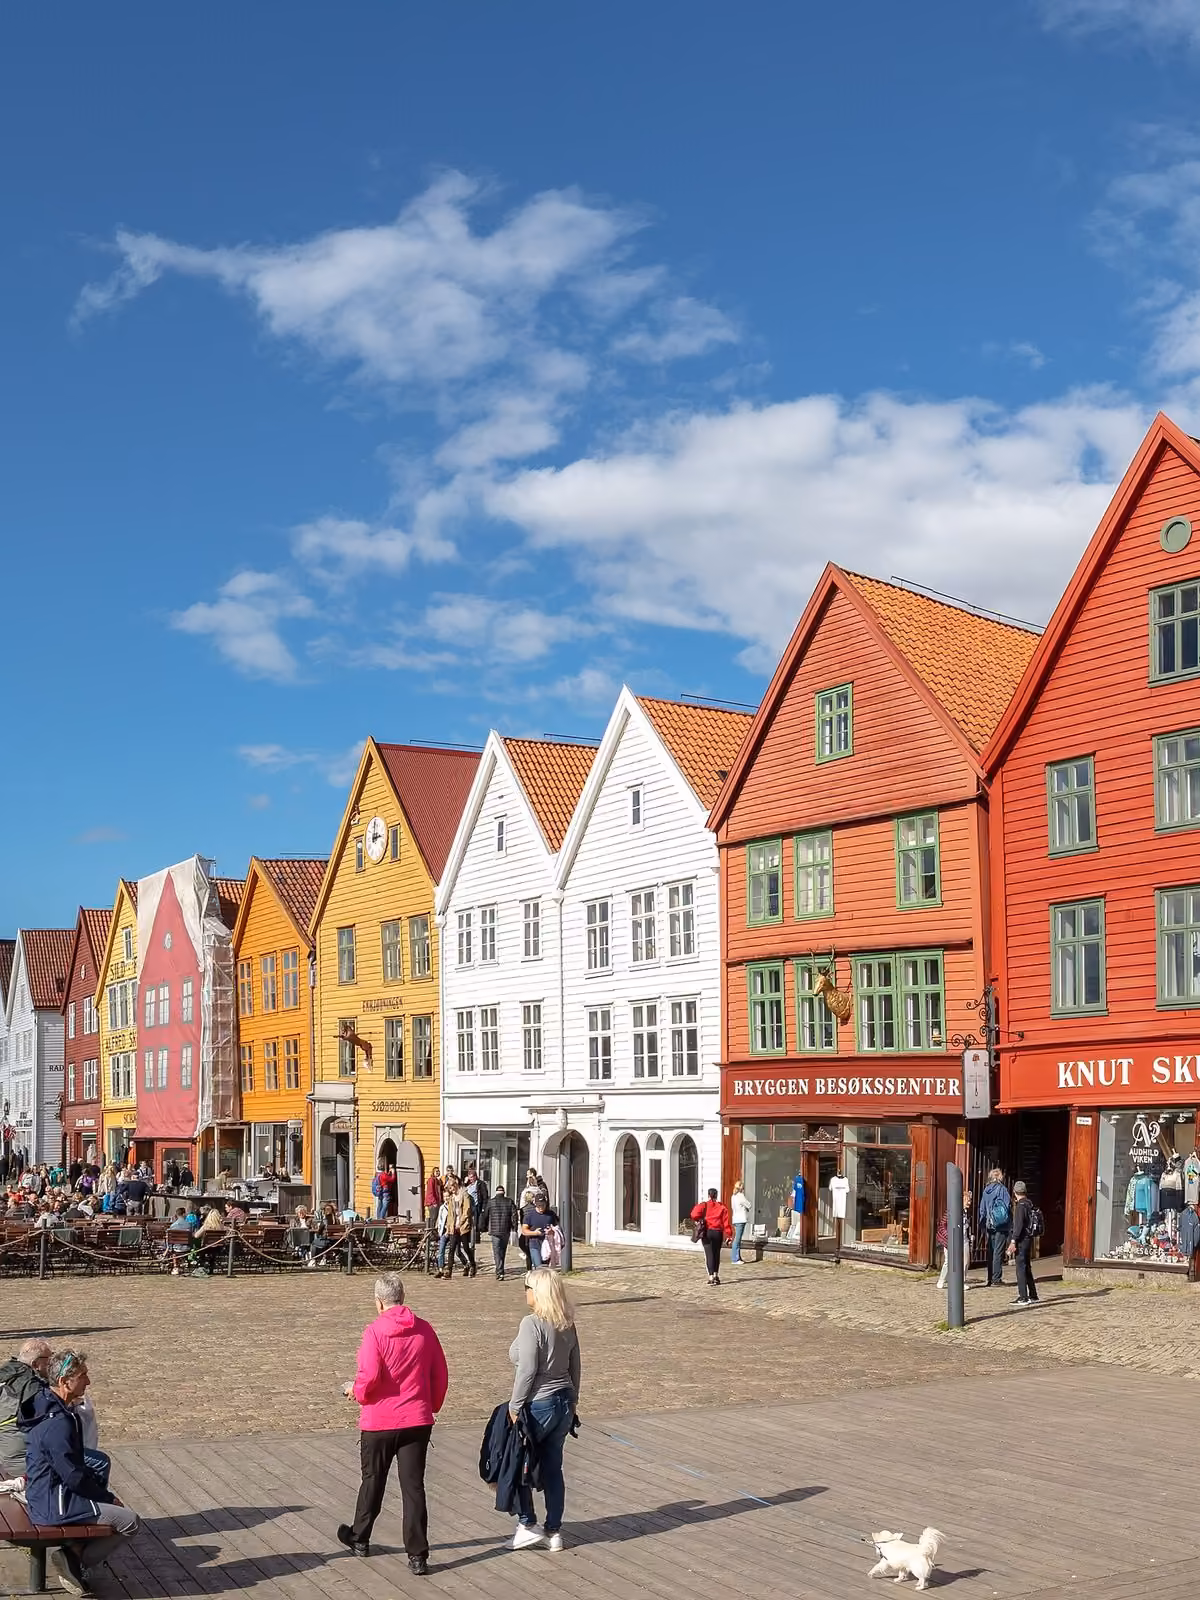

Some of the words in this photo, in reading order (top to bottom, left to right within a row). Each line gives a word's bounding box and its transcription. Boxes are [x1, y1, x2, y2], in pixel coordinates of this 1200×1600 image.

[1057, 1058, 1134, 1089] KNUT
[733, 1078, 809, 1096] BRYGGEN
[815, 1077, 961, 1096] BESØKSSENTER
[1129, 1148, 1159, 1156] AUDHILD
